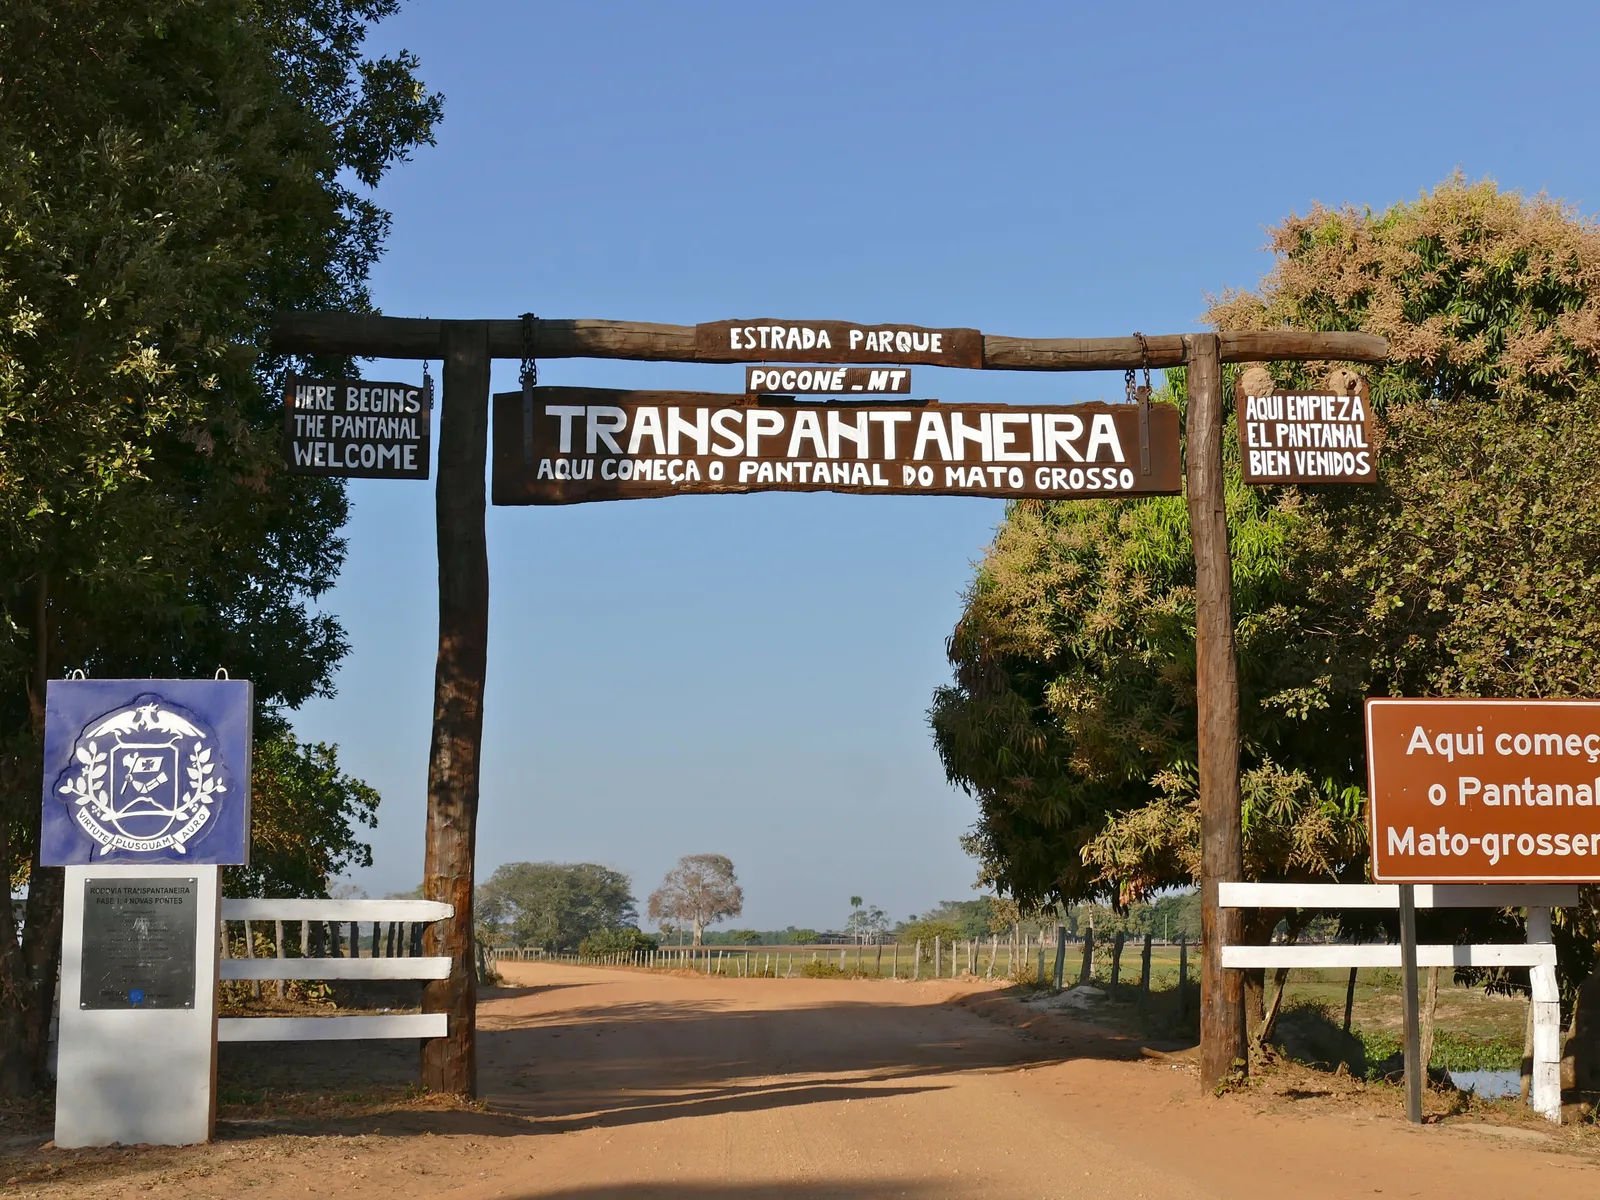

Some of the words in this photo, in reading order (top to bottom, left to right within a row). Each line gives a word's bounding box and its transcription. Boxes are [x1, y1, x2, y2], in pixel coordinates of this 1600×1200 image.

[730, 326, 831, 350] ESTRADA
[850, 330, 943, 353] PARQUE
[750, 368, 848, 391] POCONÉ
[867, 371, 906, 391] MT
[295, 385, 336, 411] HERE
[346, 387, 420, 413] BEGINS
[1246, 396, 1284, 420] AQUI
[1287, 396, 1365, 421] EMPIEZA
[294, 414, 325, 437] THE
[332, 416, 420, 439] PANTANAL
[545, 405, 1125, 462] TRANSPANTANEIRA
[1247, 422, 1272, 447] EL
[1276, 423, 1368, 448] PANTANAL
[293, 441, 418, 470] WELCOME
[1249, 450, 1291, 476] BIEN
[1294, 451, 1371, 476] VENIDOS
[537, 458, 594, 480] AQUI
[601, 459, 701, 485] COMEÇA
[709, 461, 724, 481] O
[739, 461, 889, 486] PANTANAL
[903, 465, 934, 487] DO
[945, 466, 1024, 488] MATO
[1035, 467, 1134, 489] GROSSO
[1406, 725, 1485, 763] Aqui
[1428, 782, 1447, 806] o
[1458, 776, 1600, 806] Pantanal
[78, 811, 111, 843] VIRTUTE
[115, 837, 171, 850] PLUSQUAM
[181, 813, 206, 839] AURO
[90, 887, 122, 895] RODOVIA
[123, 887, 190, 895] TRANSPANTANEIRA
[96, 897, 114, 905] FASE
[155, 897, 183, 905] PONTES
